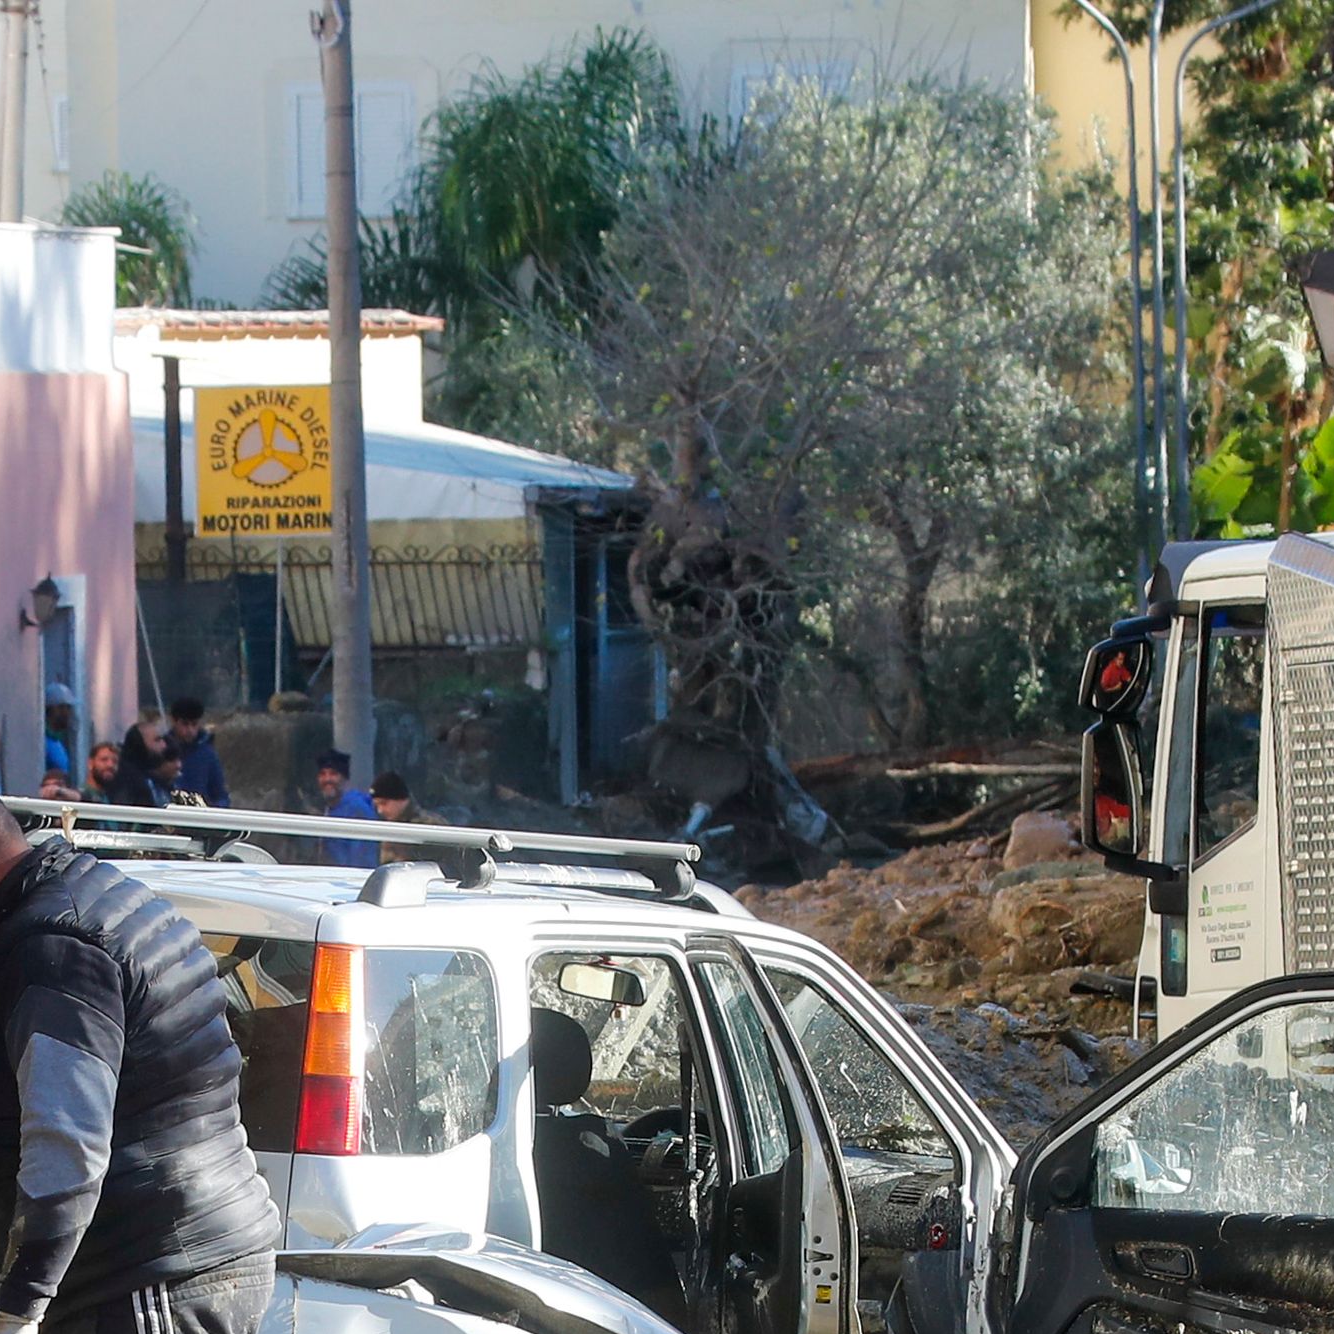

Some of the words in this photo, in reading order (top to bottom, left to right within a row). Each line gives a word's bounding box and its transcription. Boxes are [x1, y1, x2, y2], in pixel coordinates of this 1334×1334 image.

[211, 419, 231, 471] EURO
[228, 389, 299, 418] MARINE
[299, 407, 329, 470] DIESEL
[226, 495, 321, 509] RIPARAZIONI
[203, 513, 270, 532] MOTORI
[276, 511, 332, 530] MARIN
